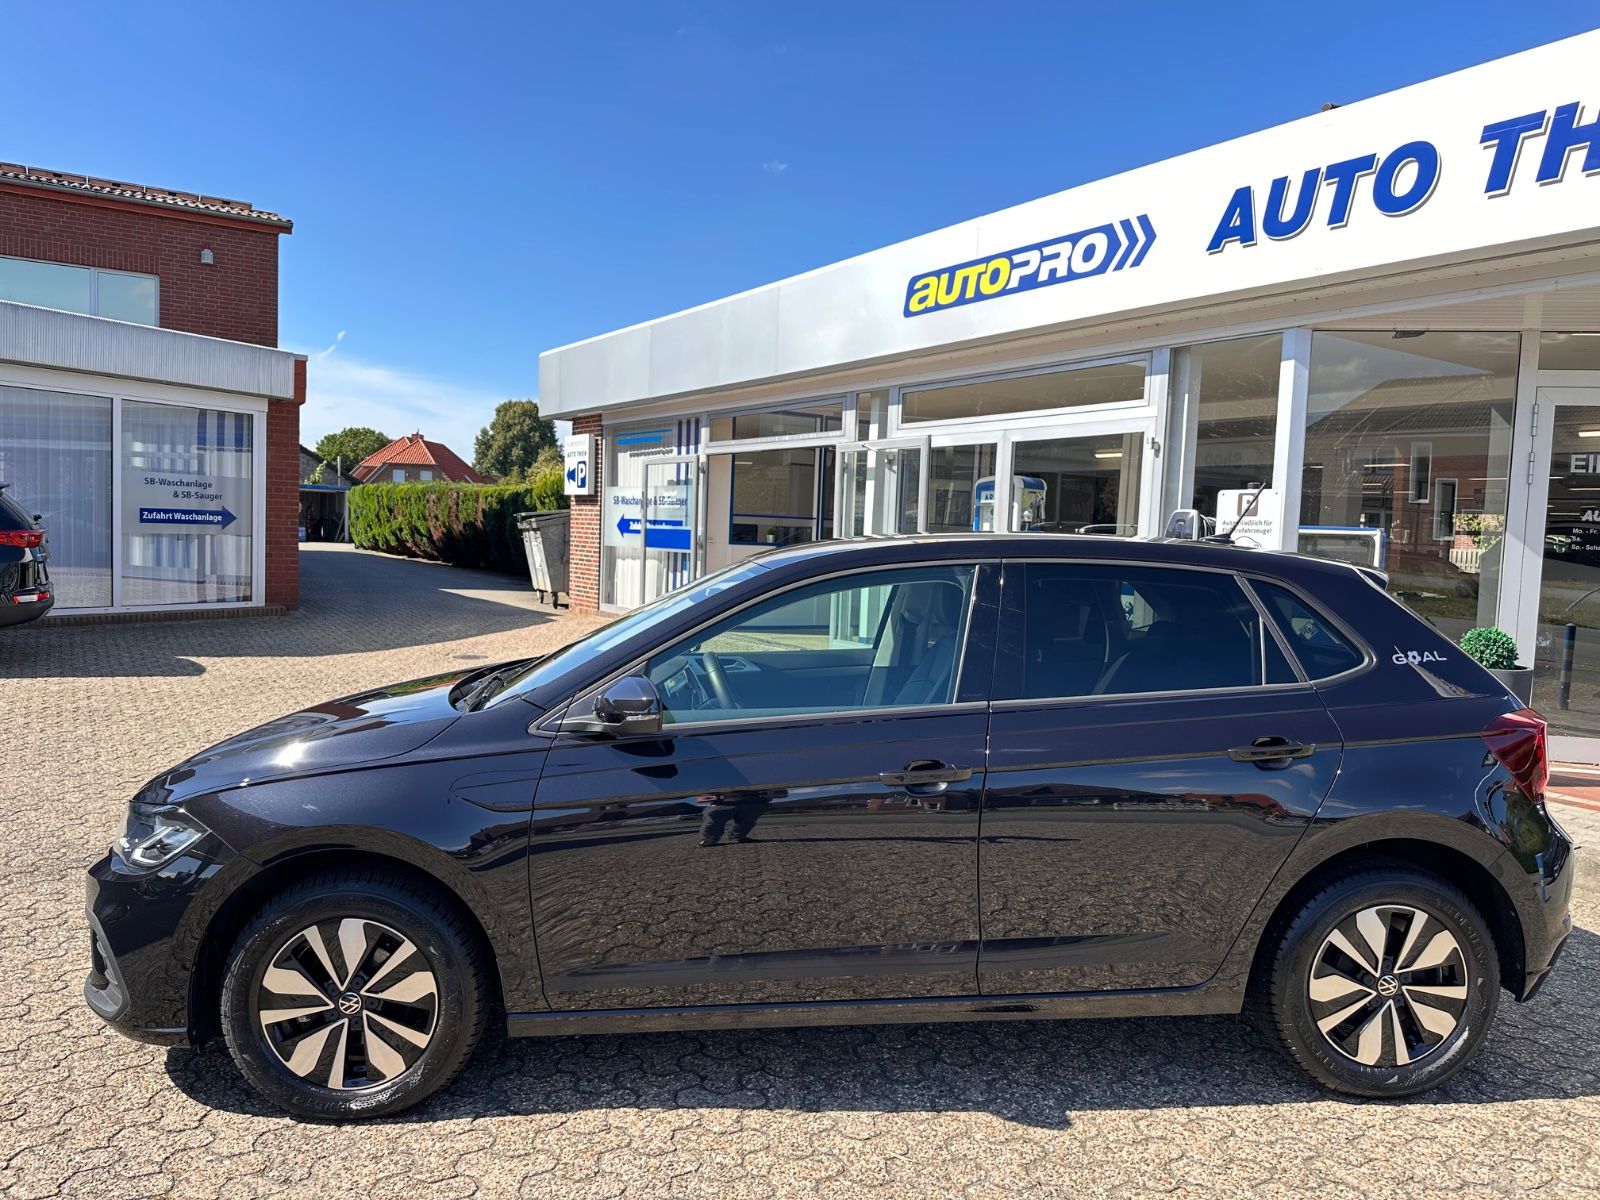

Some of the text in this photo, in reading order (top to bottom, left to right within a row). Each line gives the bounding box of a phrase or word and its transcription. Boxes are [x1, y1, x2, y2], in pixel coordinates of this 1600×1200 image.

[1206, 140, 1441, 255] AUTO
[144, 477, 212, 489] SB-Waschanlage
[173, 490, 223, 501] & SB-Sauger
[142, 511, 223, 522] Zufahrt Waschanlage
